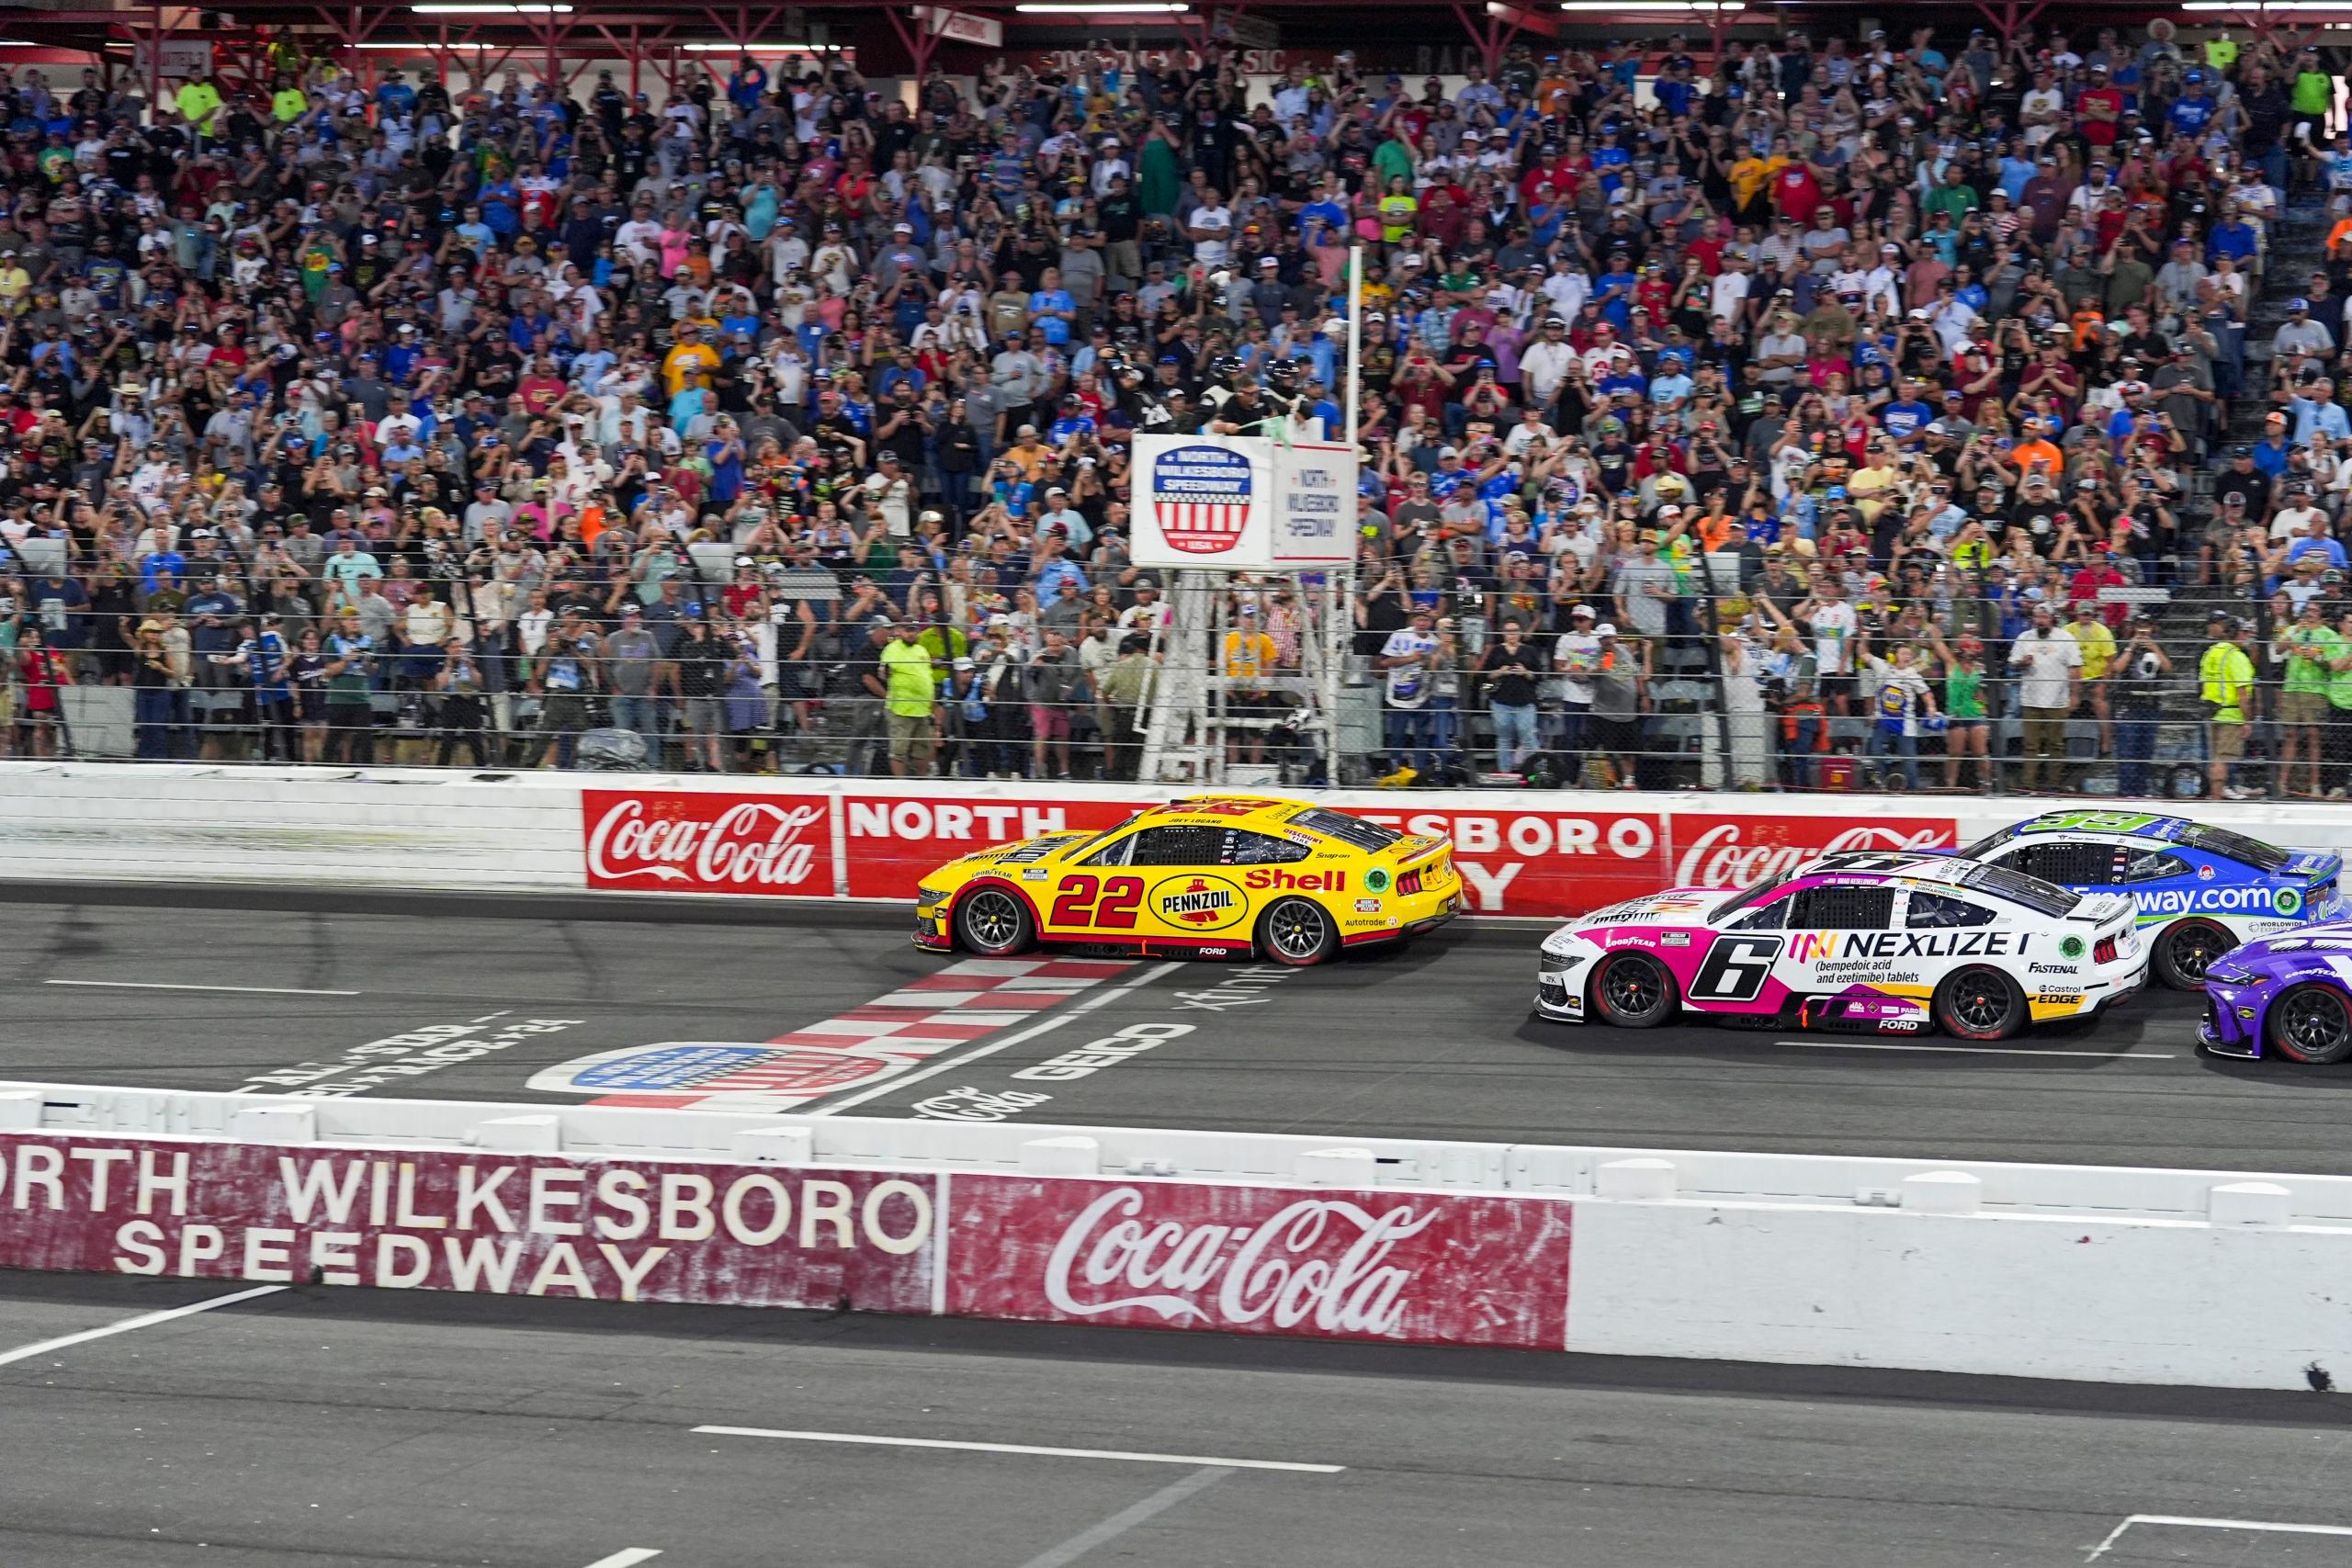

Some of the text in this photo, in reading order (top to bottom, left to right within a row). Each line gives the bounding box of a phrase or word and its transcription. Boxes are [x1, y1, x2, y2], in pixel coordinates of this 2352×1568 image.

[1177, 451, 1229, 463] NORTH
[1157, 465, 1250, 479] WILKESBORO
[1163, 479, 1242, 492] SPEEDWAY
[1186, 541, 1214, 550] USA
[847, 801, 1066, 840] NORTH
[587, 799, 827, 885] Coca-Cola
[1283, 828, 1324, 845] DISCOUNT
[1291, 836, 1309, 844] TIRE
[971, 868, 1012, 879] GOODYEAR
[1245, 869, 1346, 892] Shell
[1915, 886, 1963, 898] SUBMARINES.COM
[1048, 874, 1146, 929] 22
[1162, 890, 1234, 914] PENNZOIL
[2073, 887, 2272, 917] way.com
[1345, 919, 1386, 927] Autotrader
[1199, 947, 1227, 957] FORD
[1688, 933, 1784, 1001] 6
[1815, 959, 1892, 972] (bempedoic acid
[2029, 962, 2078, 975] FASTENAL
[1816, 971, 1919, 984] and ezetimibe) tablets
[2285, 968, 2342, 979] GOODYEA
[2048, 985, 2081, 993] Castrol
[2038, 995, 2082, 1004] EDGE
[1879, 1020, 1918, 1031] FORD
[359, 1039, 520, 1075] RACE
[503, 1019, 587, 1032] 24
[1010, 1022, 1197, 1080] GEICO
[0, 1145, 933, 1256] RTH WILKESBORO
[114, 1220, 671, 1302] SPEEDWAY
[1045, 1187, 1441, 1335] Coca-Cola
